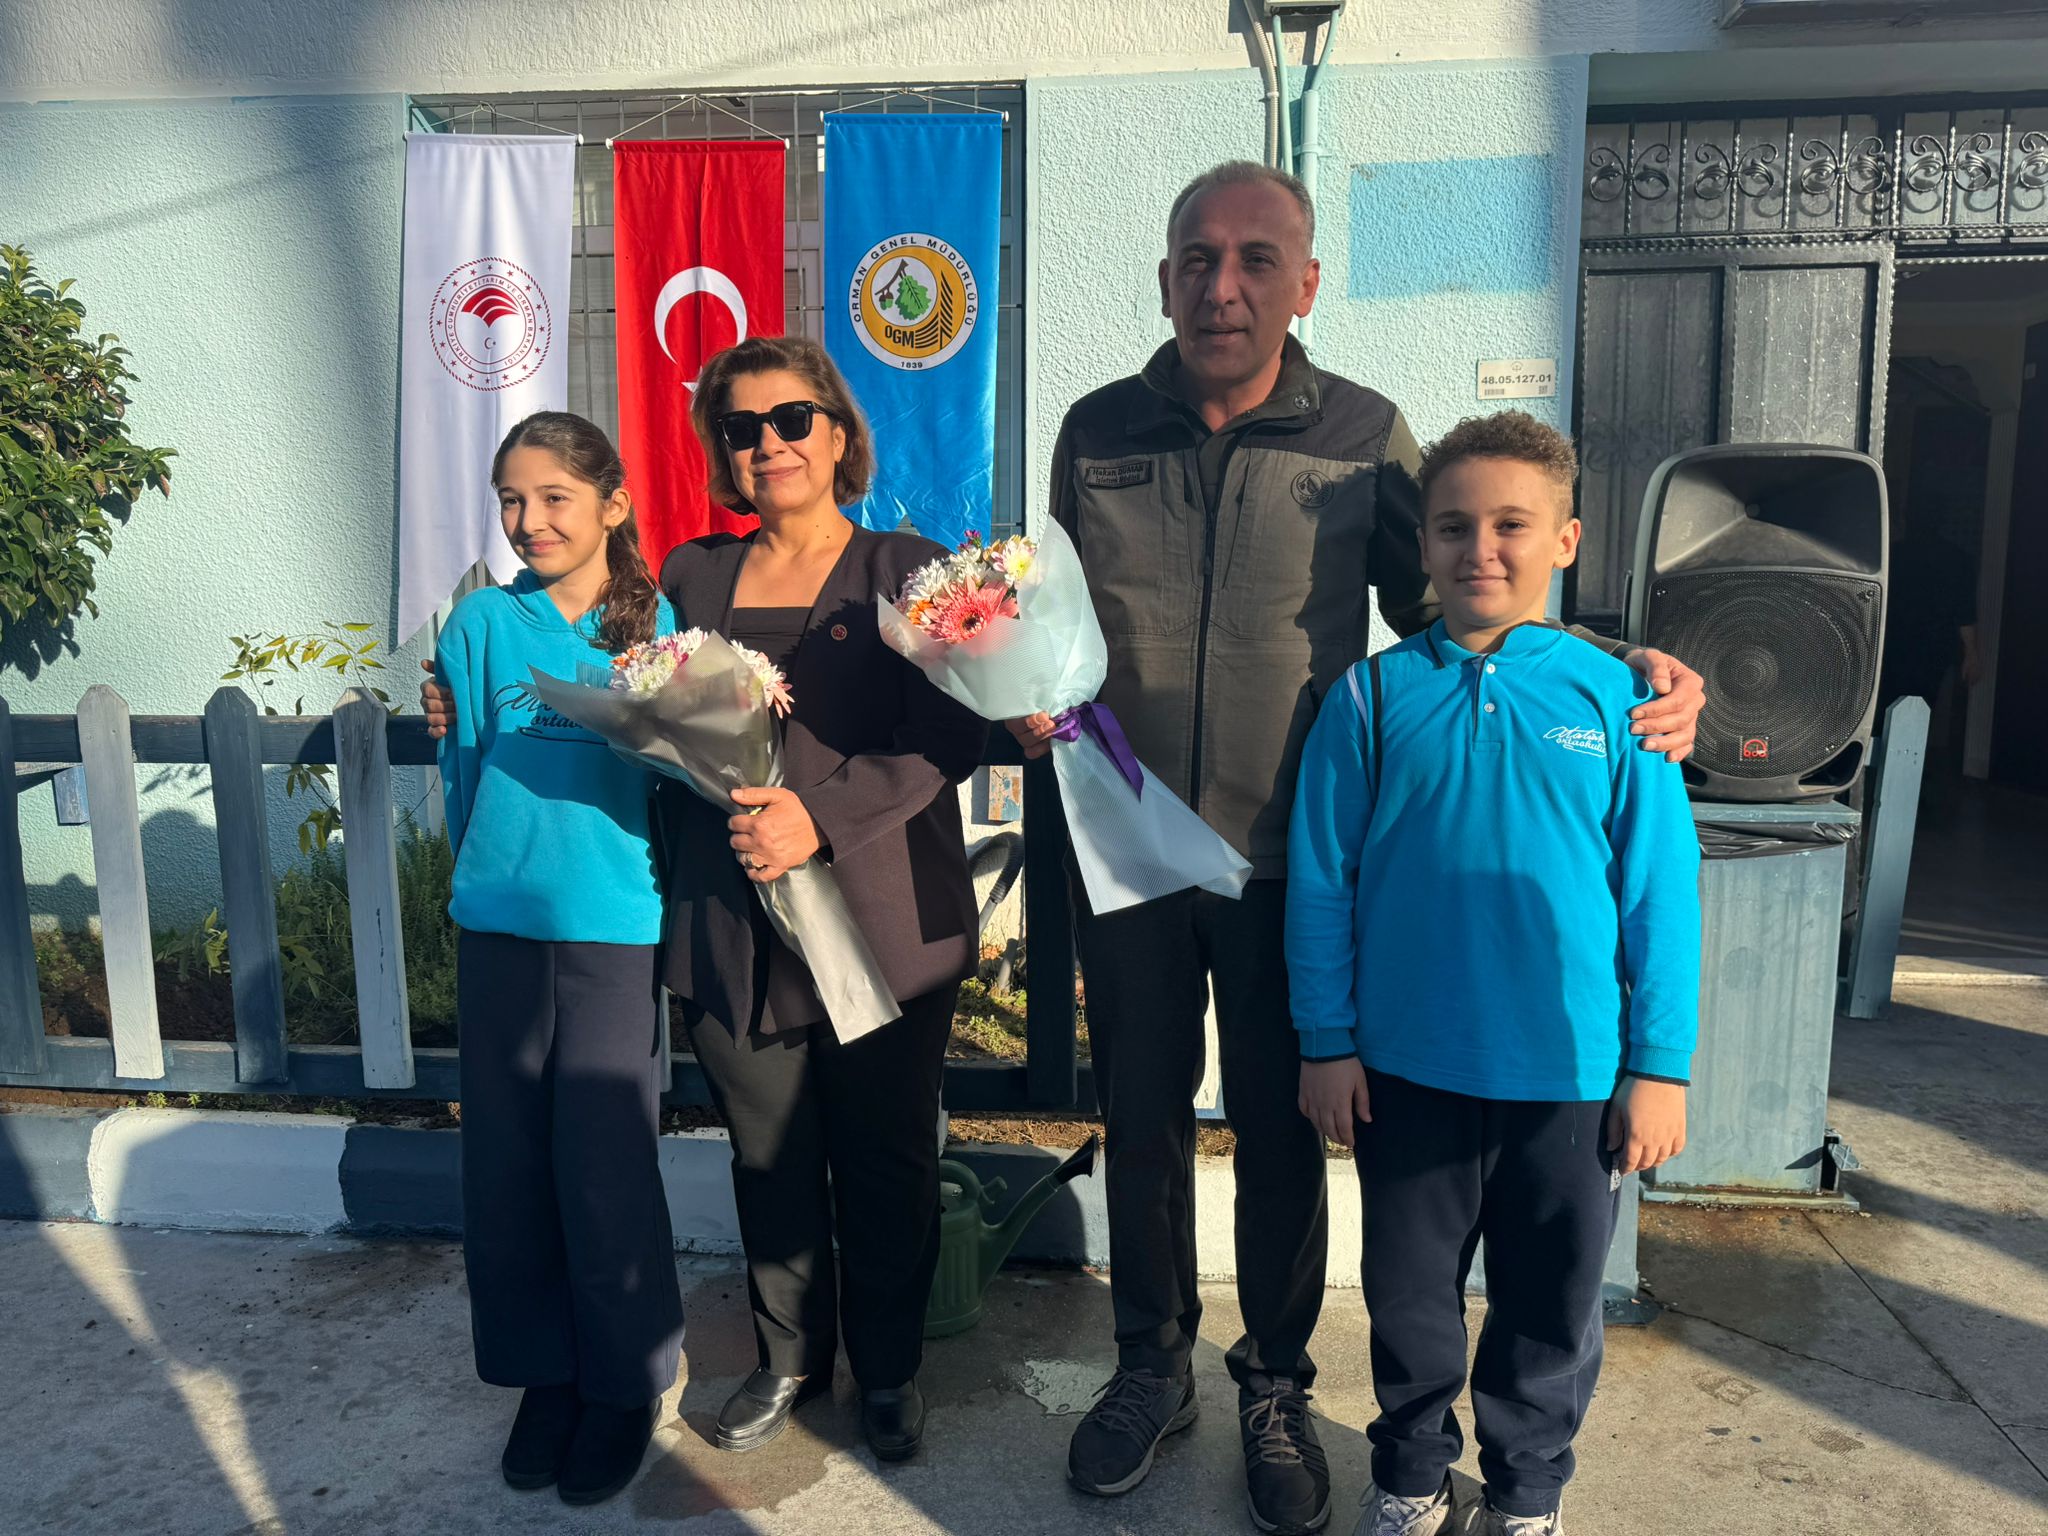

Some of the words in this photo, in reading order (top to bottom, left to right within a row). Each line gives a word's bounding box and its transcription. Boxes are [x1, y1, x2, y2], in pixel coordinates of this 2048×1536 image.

[852, 266, 868, 323] ORMAN
[870, 236, 917, 260] GENEL
[926, 238, 977, 326] MÜDÜRLÜĞÜ
[482, 277, 505, 286] TARIM
[507, 283, 517, 293] VE
[517, 294, 534, 323] ORMAN
[884, 325, 915, 349] OGM
[900, 361, 923, 369] 1839
[1481, 374, 1552, 385] 48.05.127.01
